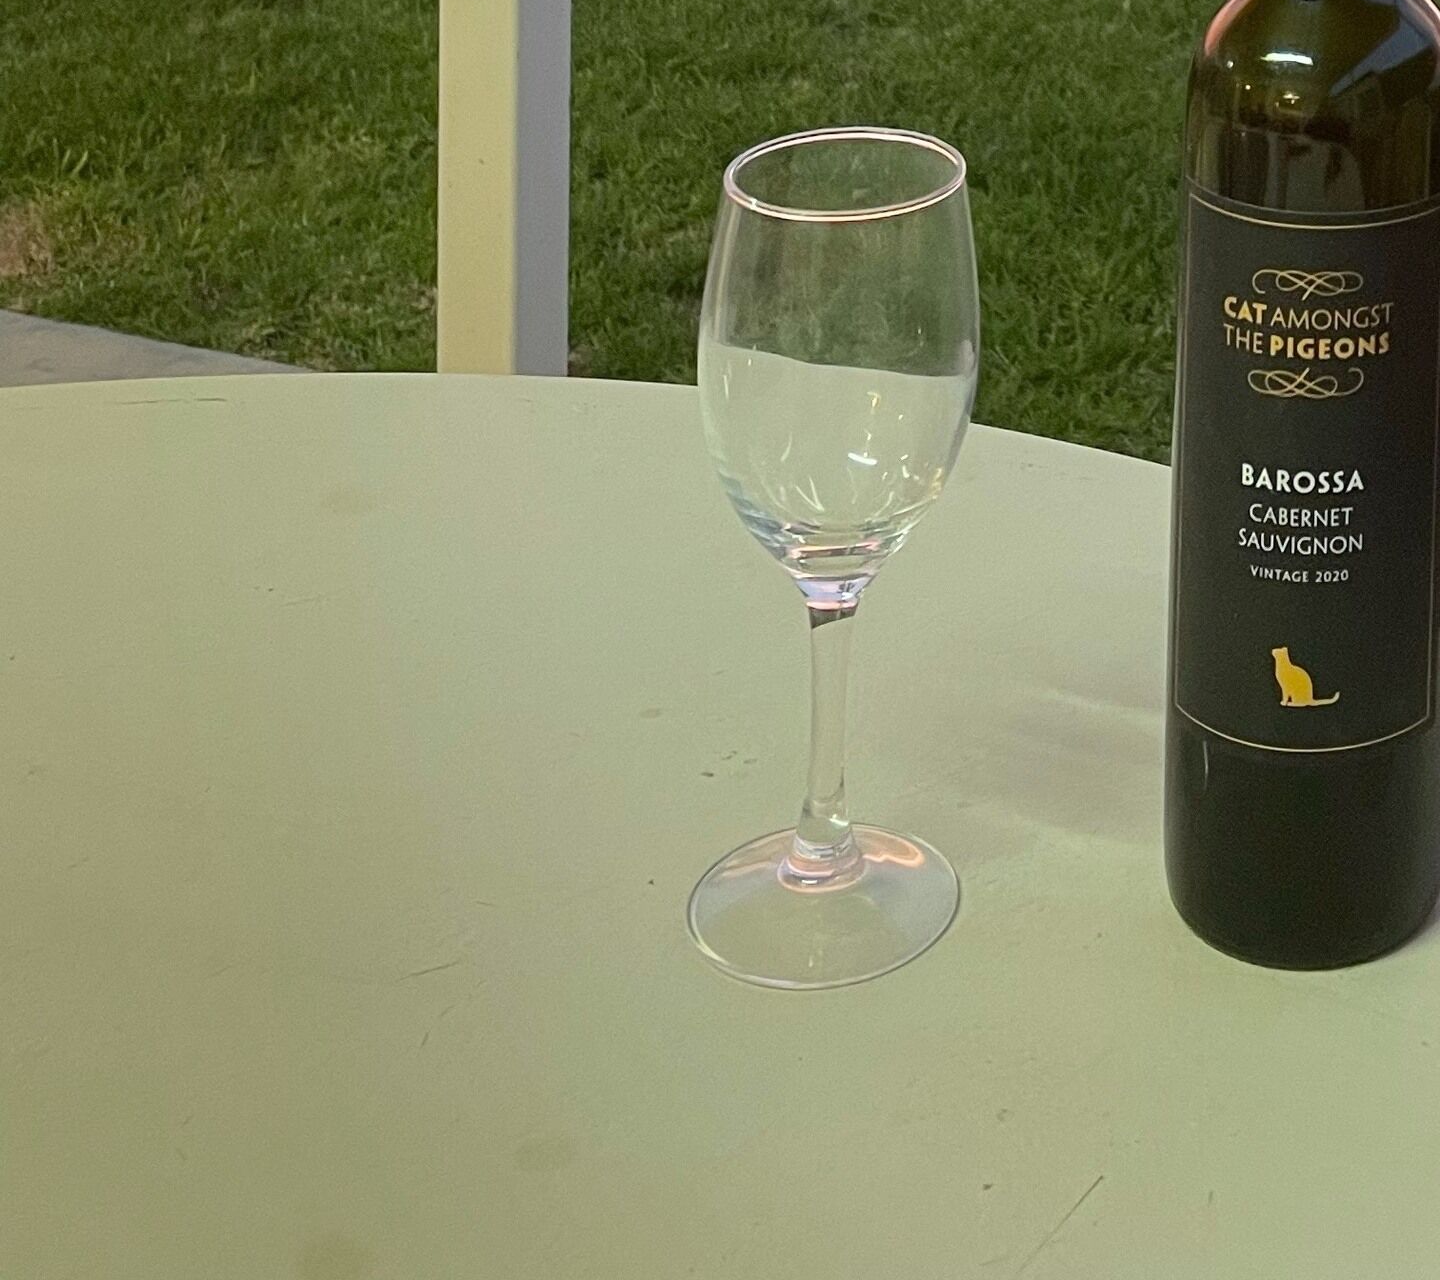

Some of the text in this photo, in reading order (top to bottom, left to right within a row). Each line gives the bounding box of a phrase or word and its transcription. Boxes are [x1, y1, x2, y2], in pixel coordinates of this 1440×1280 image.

[1223, 296, 1394, 330] CAT AMONGST
[1223, 324, 1389, 360] THE PIGEONS
[1241, 463, 1364, 494] BAROSSA
[1249, 503, 1353, 527] CABERNET
[1238, 528, 1363, 555] SAUVIGNON
[1250, 564, 1349, 583] VINTAGE 2020
